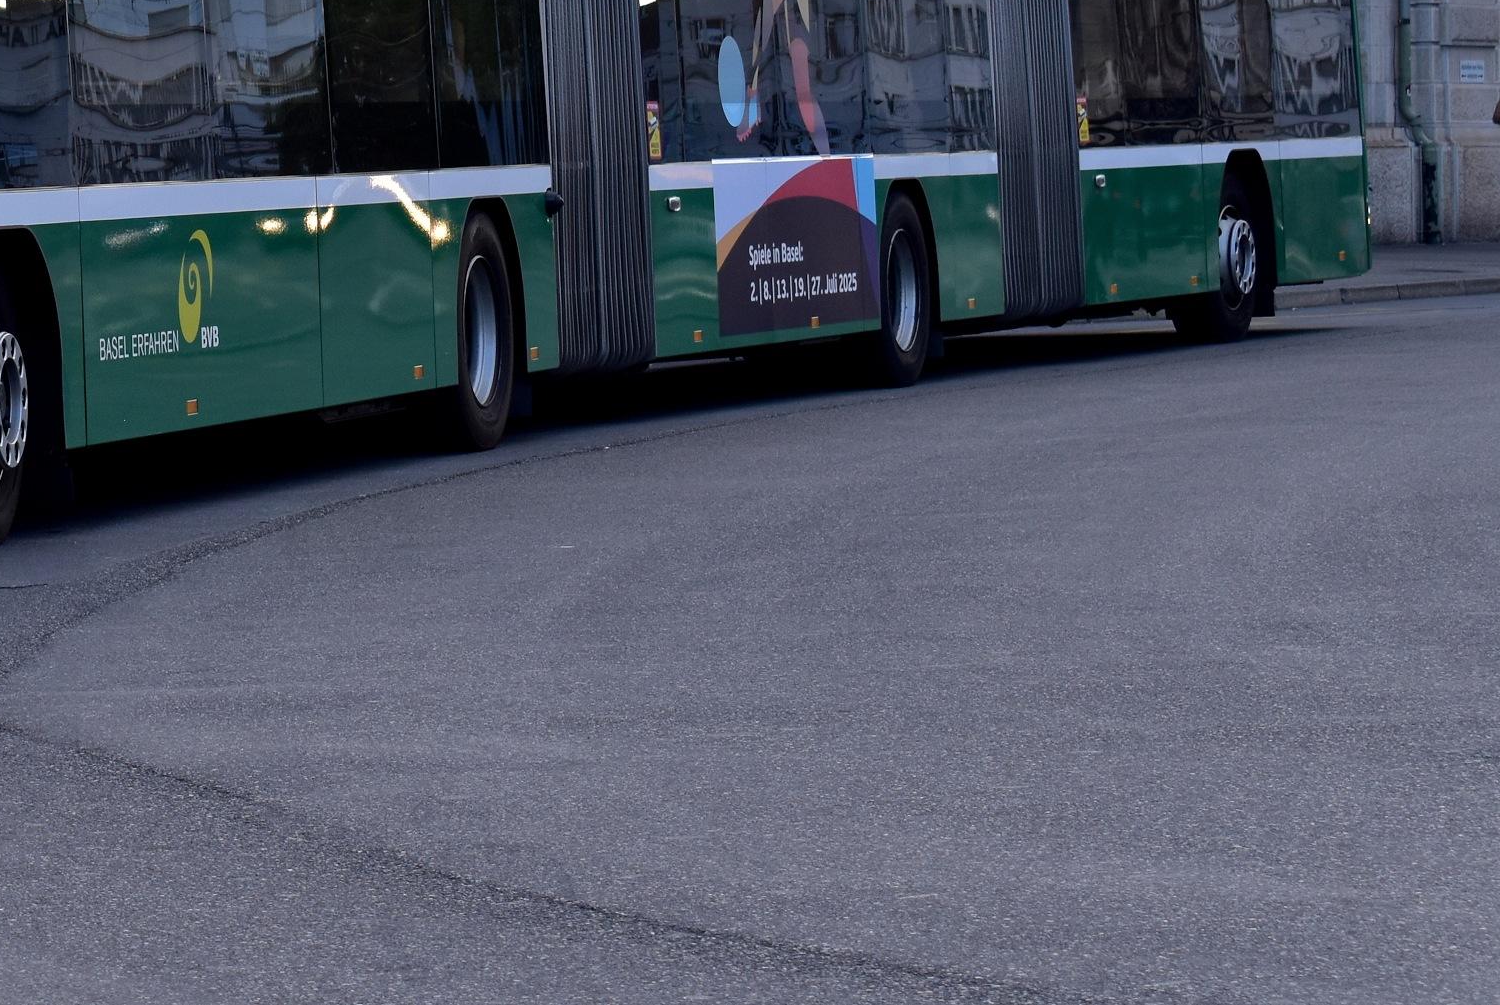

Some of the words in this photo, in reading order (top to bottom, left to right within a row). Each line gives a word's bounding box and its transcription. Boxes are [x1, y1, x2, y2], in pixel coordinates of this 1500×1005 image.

[749, 243, 771, 271] Spiele
[772, 242, 780, 264] in
[781, 240, 803, 263] Basel:
[824, 273, 838, 294] Juli
[838, 272, 857, 293] 2025
[100, 336, 129, 361] BASEL
[132, 330, 179, 357] ERFAHREN
[200, 325, 219, 349] BVB
